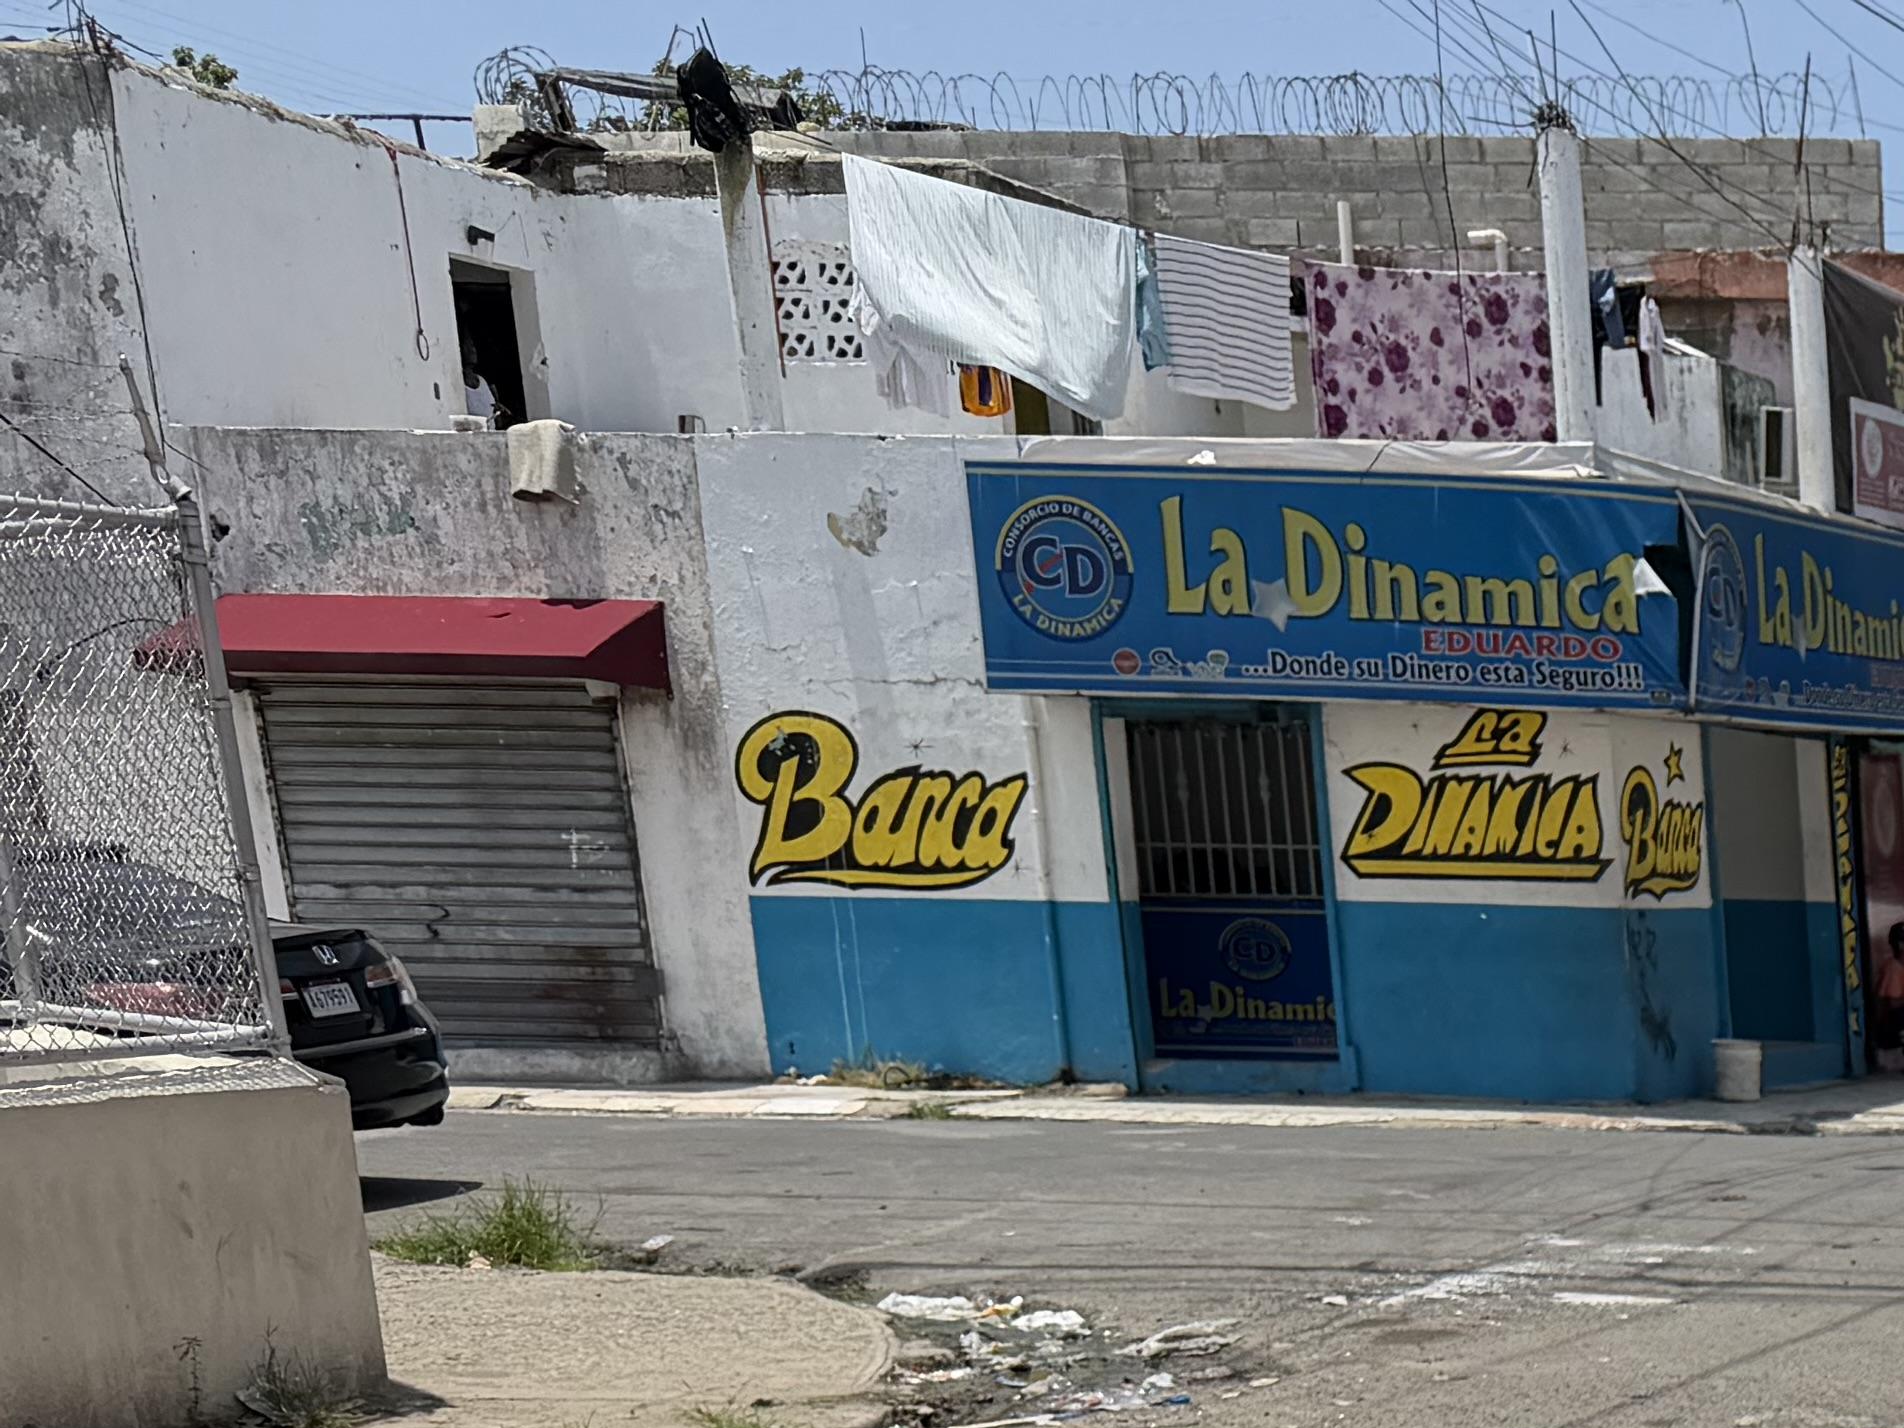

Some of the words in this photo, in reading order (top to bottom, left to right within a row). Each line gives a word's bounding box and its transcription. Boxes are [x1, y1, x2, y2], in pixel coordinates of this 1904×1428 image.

[1003, 502, 1059, 558] CONSORCIO
[1062, 503, 1081, 517] DE
[1081, 508, 1124, 561] BANCAS
[1021, 535, 1106, 598] CD
[1160, 495, 1250, 617] La
[1282, 506, 1640, 634] Dinamica
[1755, 532, 1793, 647] La
[1012, 594, 1034, 620] LA
[1035, 597, 1124, 639] DINAMICA
[1422, 628, 1623, 662] EDUARDO
[1354, 658, 1381, 680] su
[1389, 653, 1470, 683] Dinero
[1479, 663, 1525, 685] esta
[1535, 662, 1645, 692] Seguro!!!
[735, 709, 1028, 888] Banca
[1620, 765, 1703, 892] Banca
[1160, 977, 1195, 1018] La
[1210, 981, 1336, 1021] Dinamic
